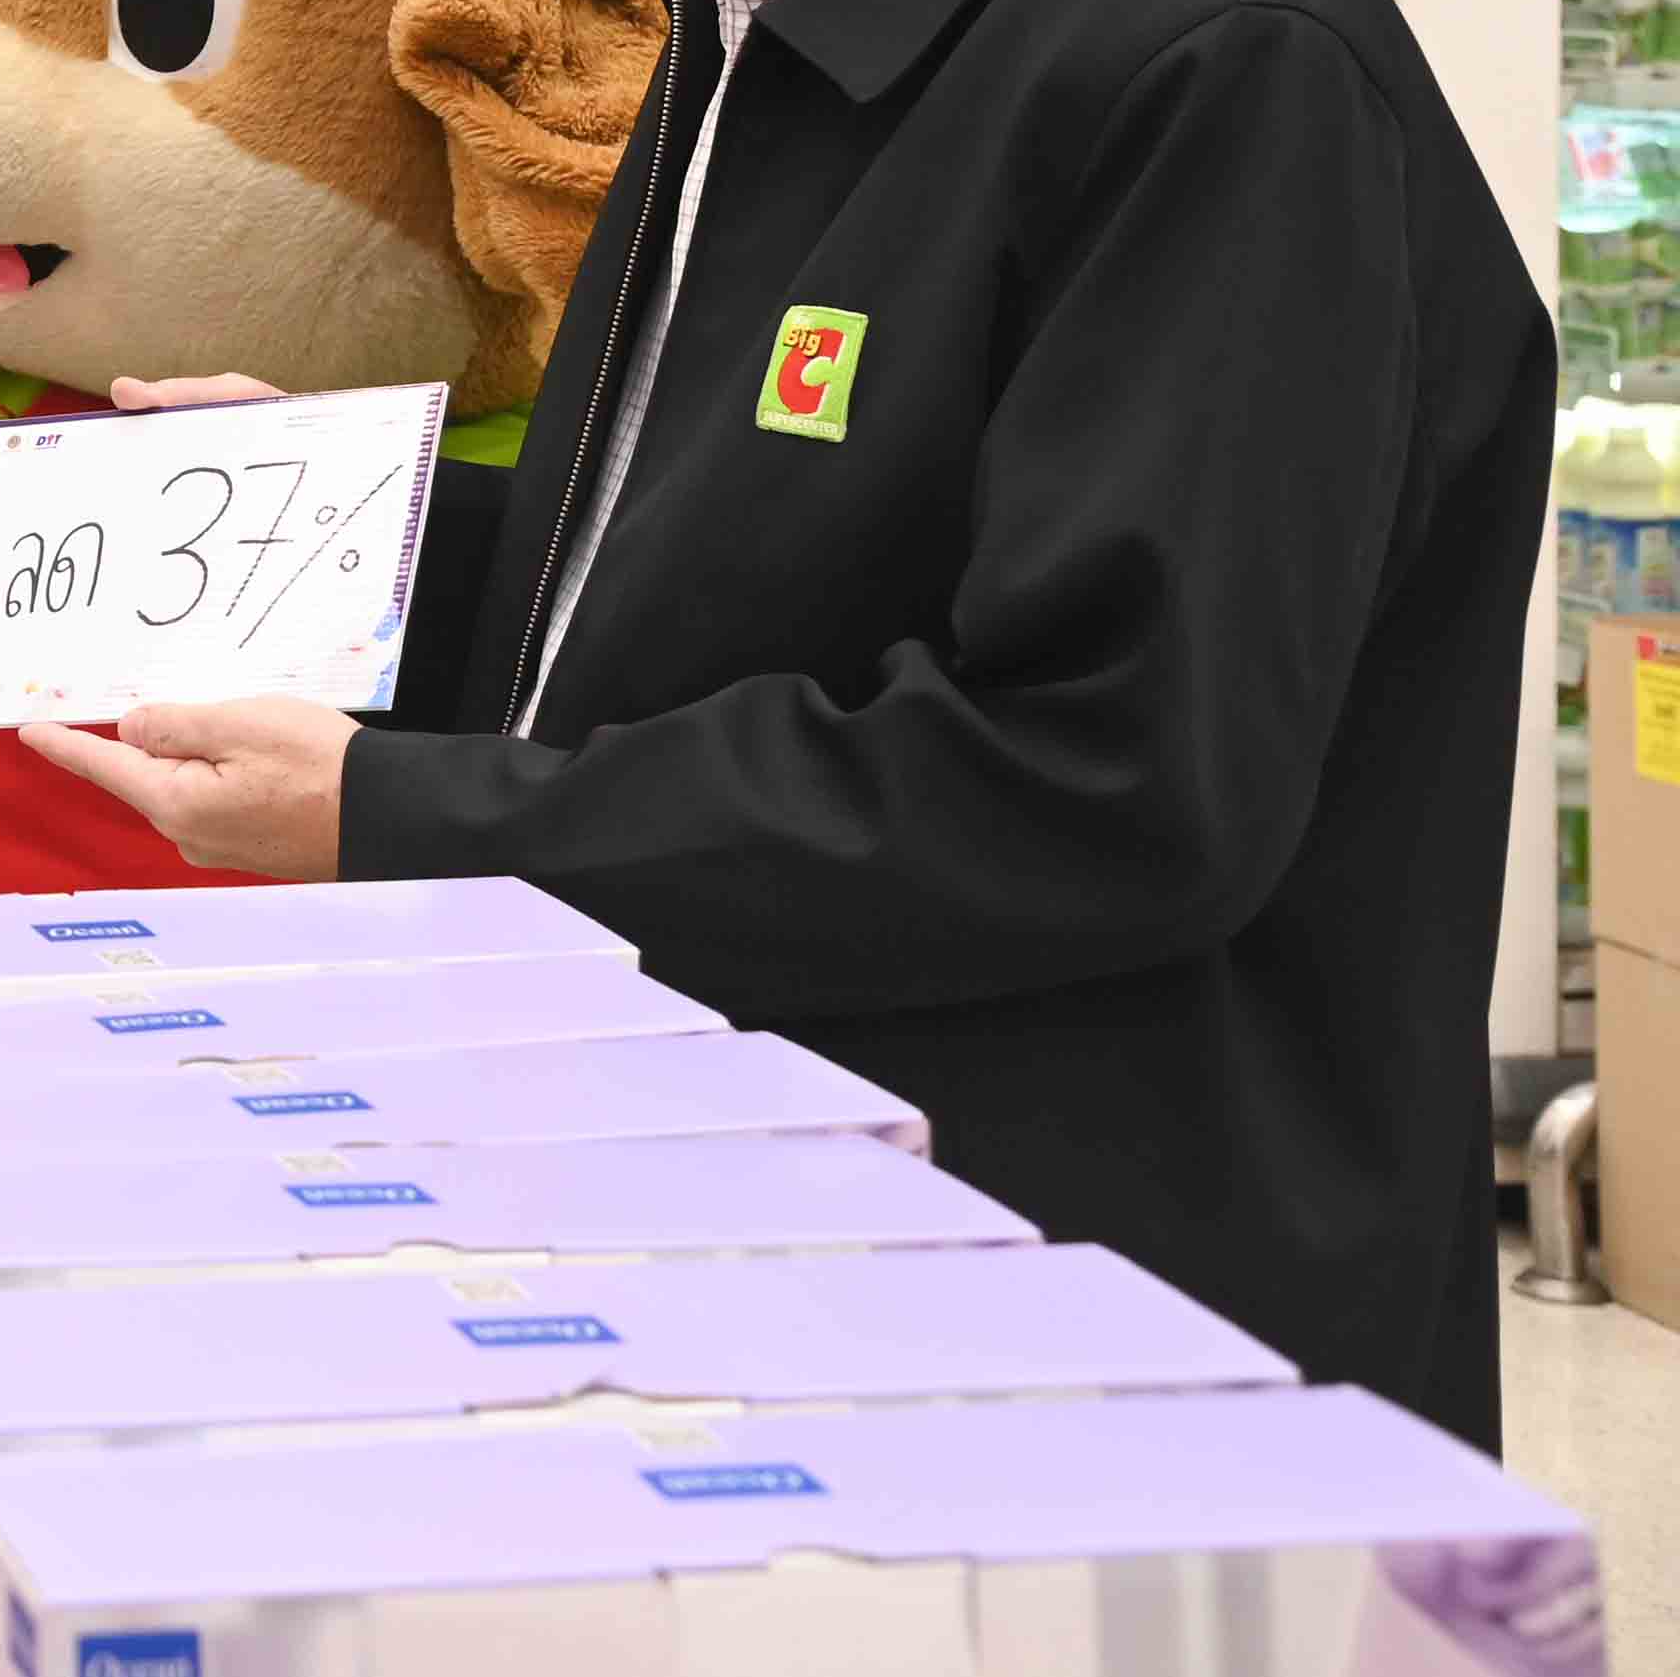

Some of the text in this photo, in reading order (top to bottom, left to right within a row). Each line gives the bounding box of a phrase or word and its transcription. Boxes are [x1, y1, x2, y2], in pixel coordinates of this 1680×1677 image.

[784, 323, 822, 357] Big
[4, 460, 404, 650] ลด 37%
[47, 923, 140, 939] Ocean
